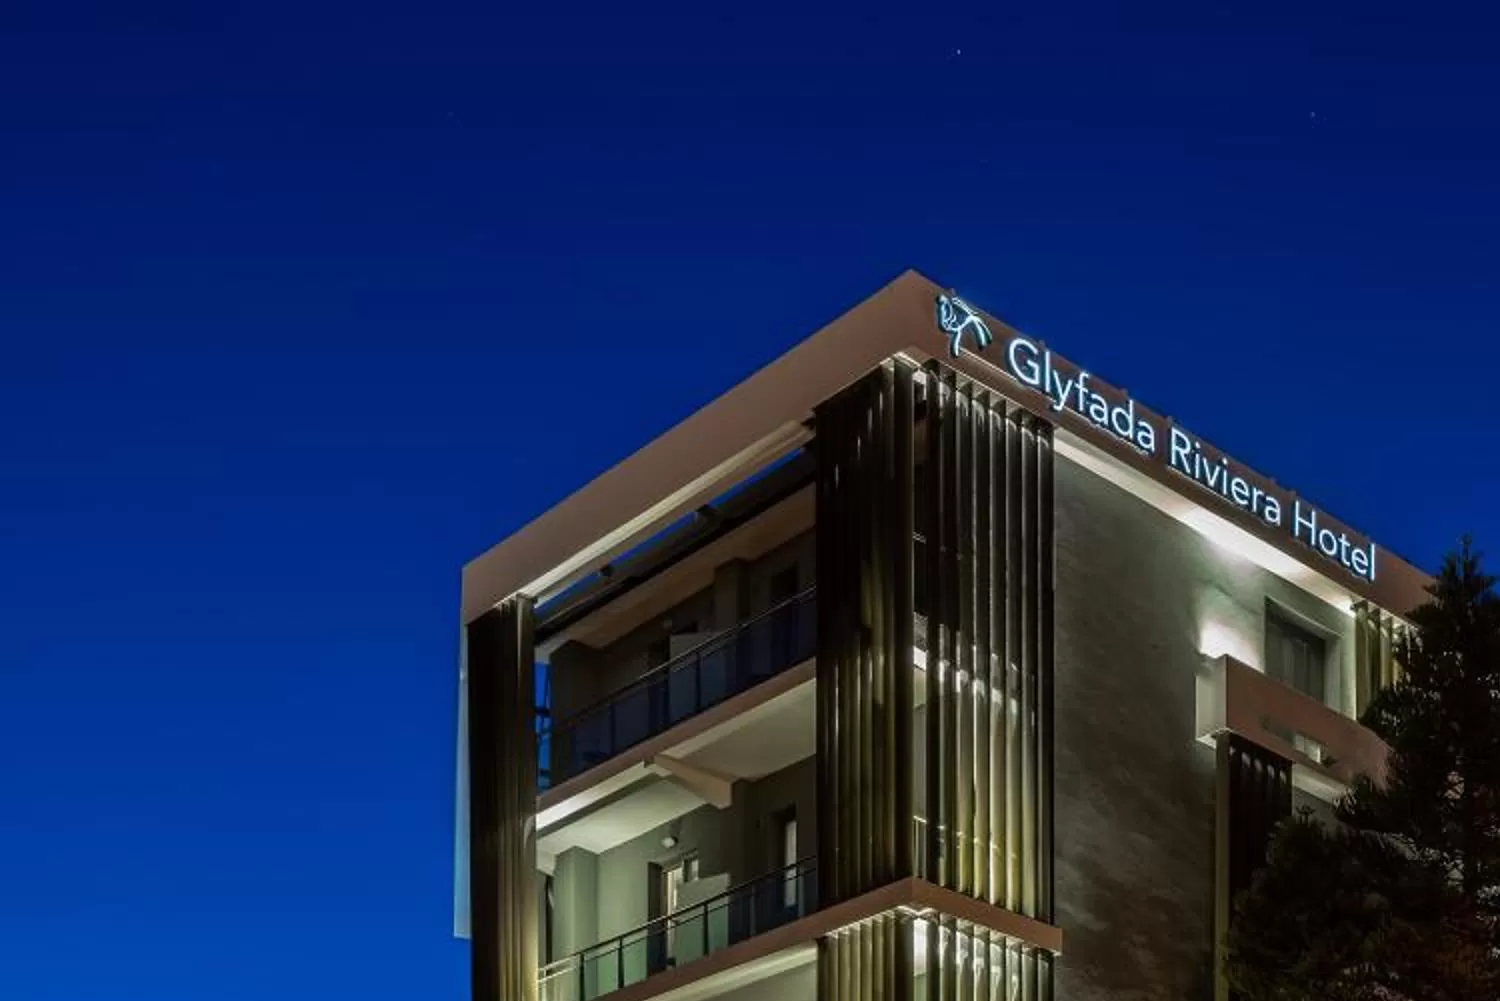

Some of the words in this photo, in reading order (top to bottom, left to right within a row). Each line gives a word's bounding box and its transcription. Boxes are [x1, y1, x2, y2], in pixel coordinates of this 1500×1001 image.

[1008, 337, 1157, 453] Glyfada
[1170, 427, 1282, 527] Riviera
[1294, 500, 1377, 581] Hotel
